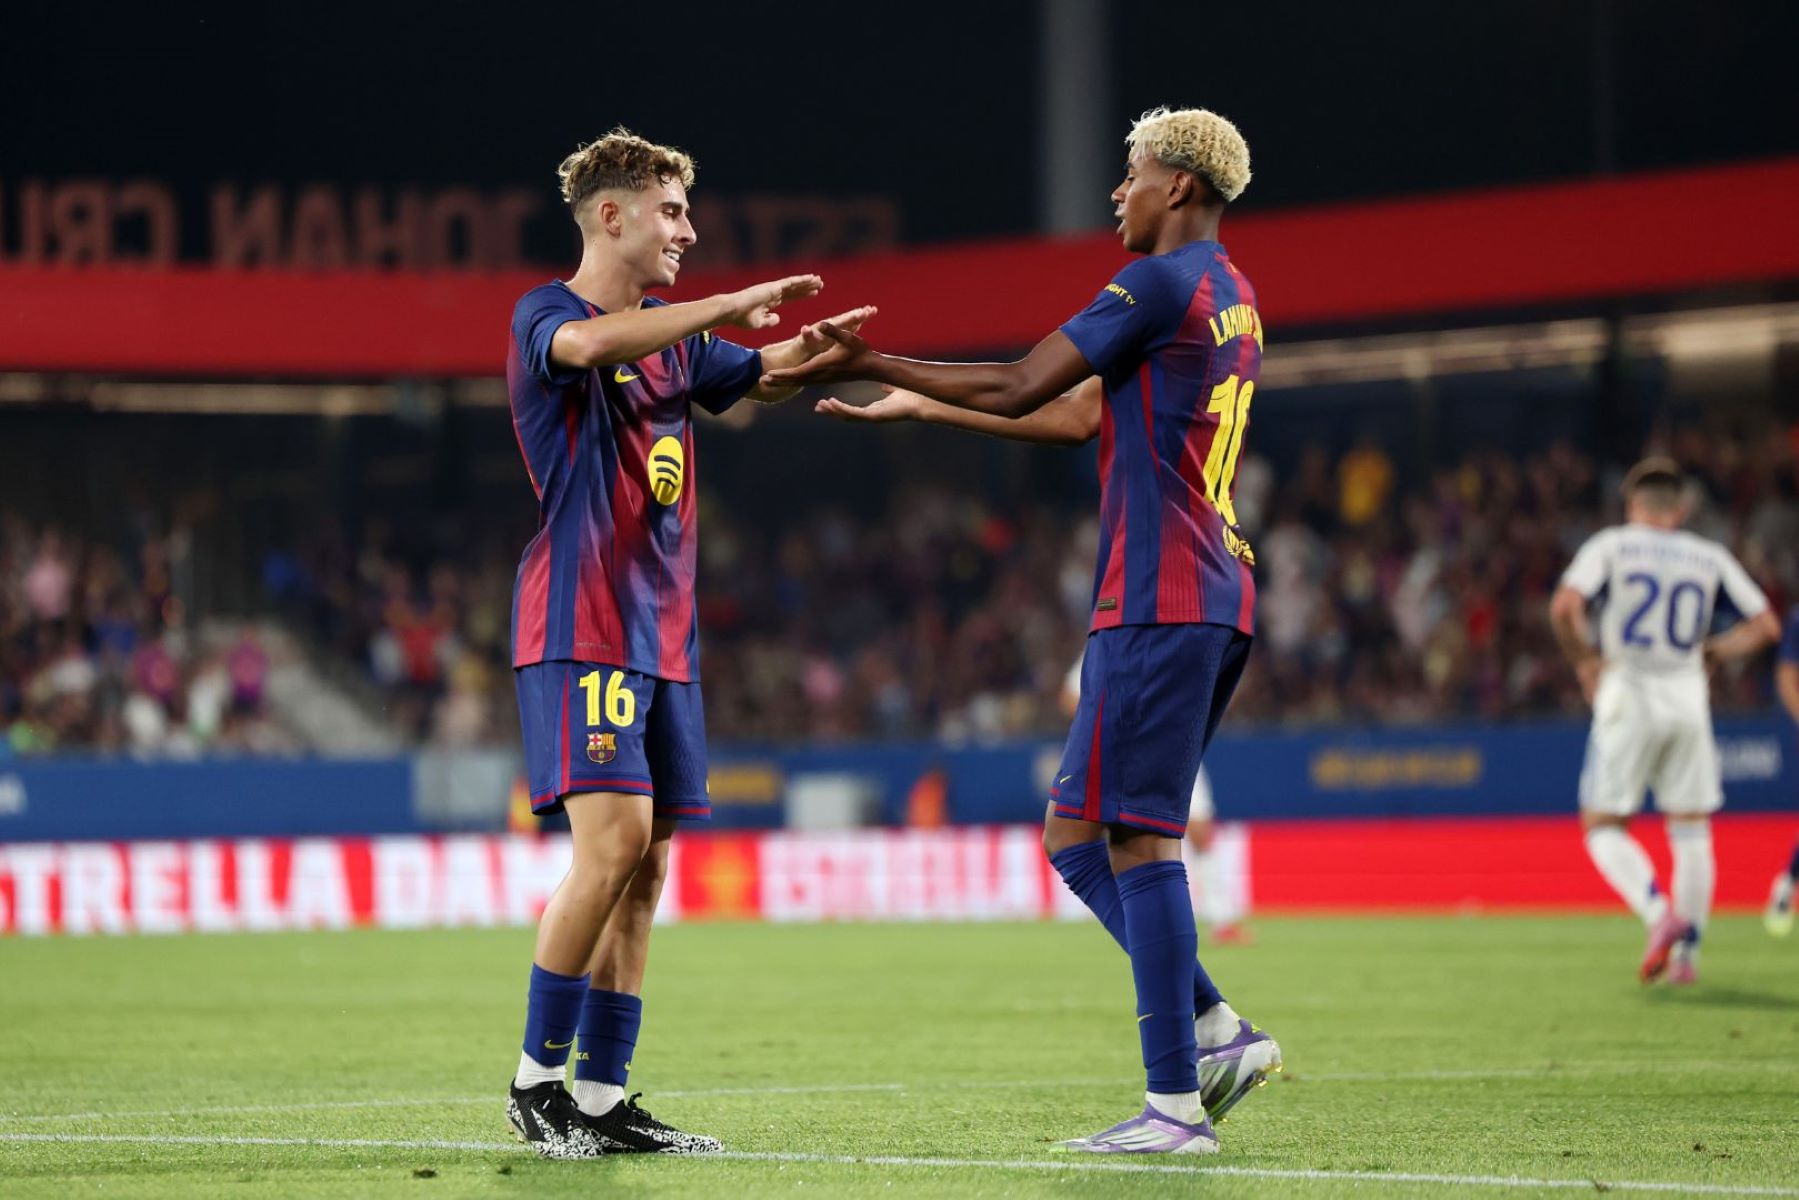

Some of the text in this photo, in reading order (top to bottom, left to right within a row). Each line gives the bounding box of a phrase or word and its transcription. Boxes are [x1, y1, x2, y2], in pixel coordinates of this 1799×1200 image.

[1202, 374, 1254, 528] 10
[1622, 571, 1706, 651] 20
[579, 670, 635, 728] 16
